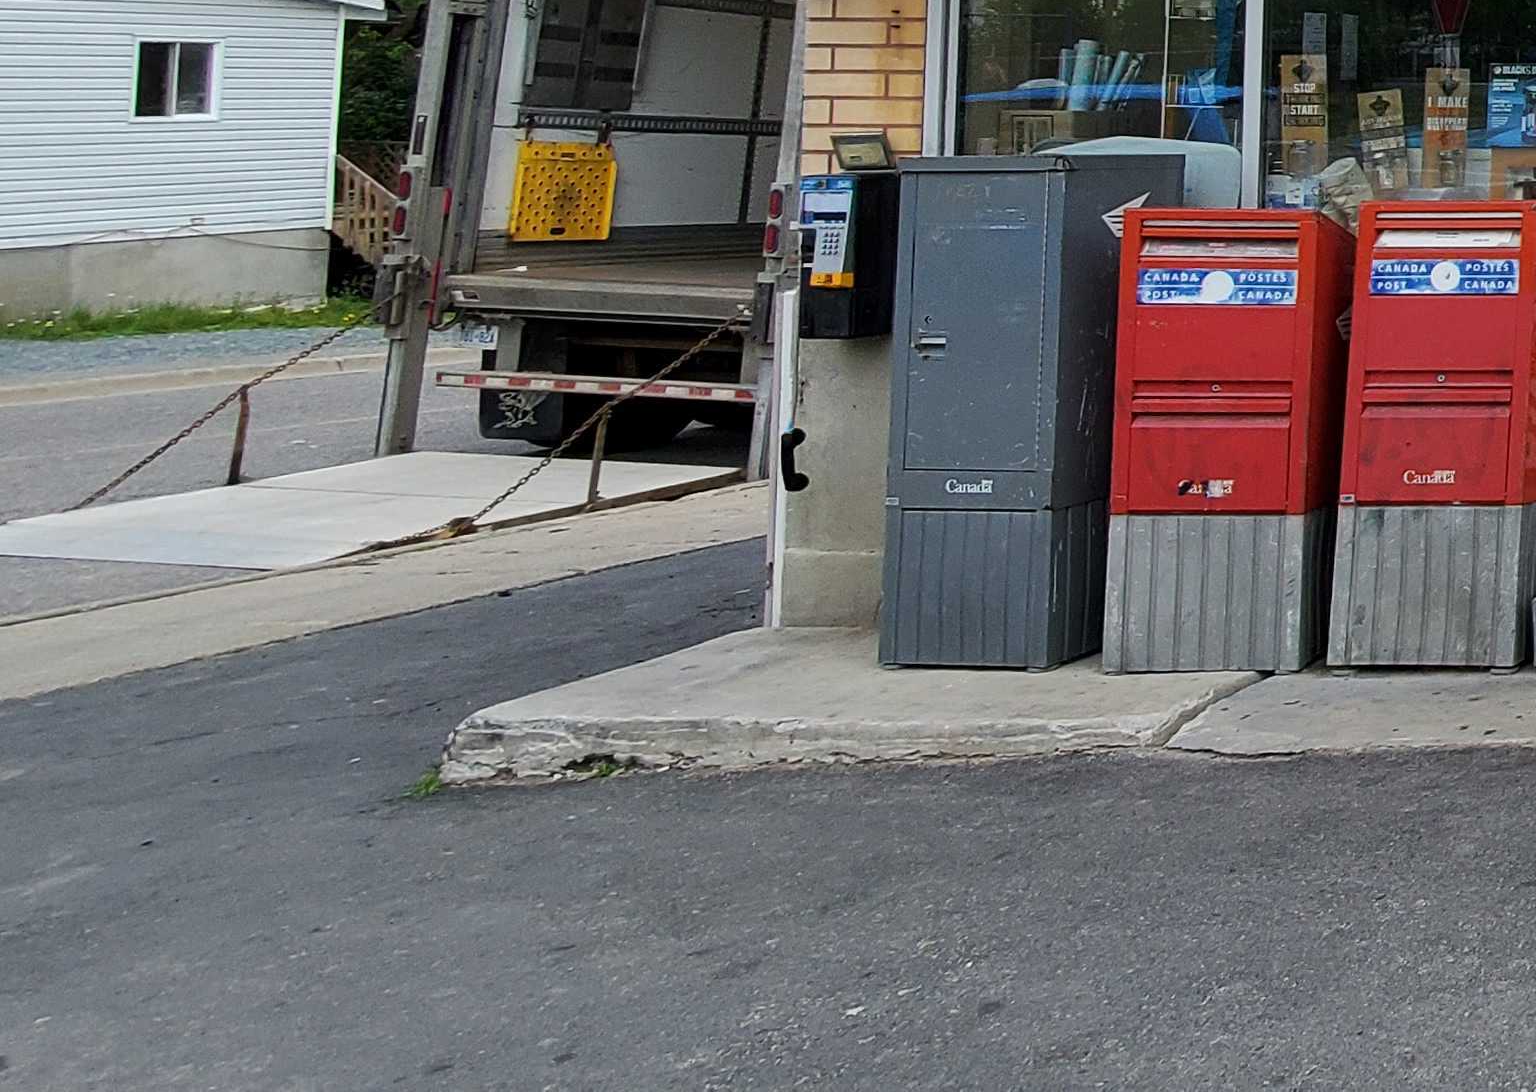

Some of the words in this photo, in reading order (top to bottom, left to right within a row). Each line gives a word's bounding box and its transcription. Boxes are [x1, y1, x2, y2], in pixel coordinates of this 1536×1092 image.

[1293, 83, 1316, 94] STOP
[1438, 96, 1468, 108] MAKE
[1290, 105, 1319, 116] START
[1377, 264, 1427, 273] CANADA
[1465, 263, 1510, 272] POSTES
[1143, 270, 1200, 283] CANADA
[1239, 271, 1288, 283] POSTES
[1377, 281, 1408, 290] POST
[1464, 281, 1513, 290] CANADA
[1145, 289, 1177, 300] POST
[1239, 290, 1291, 301] CANADA
[1403, 470, 1456, 485] Canada
[945, 478, 993, 494] Canada
